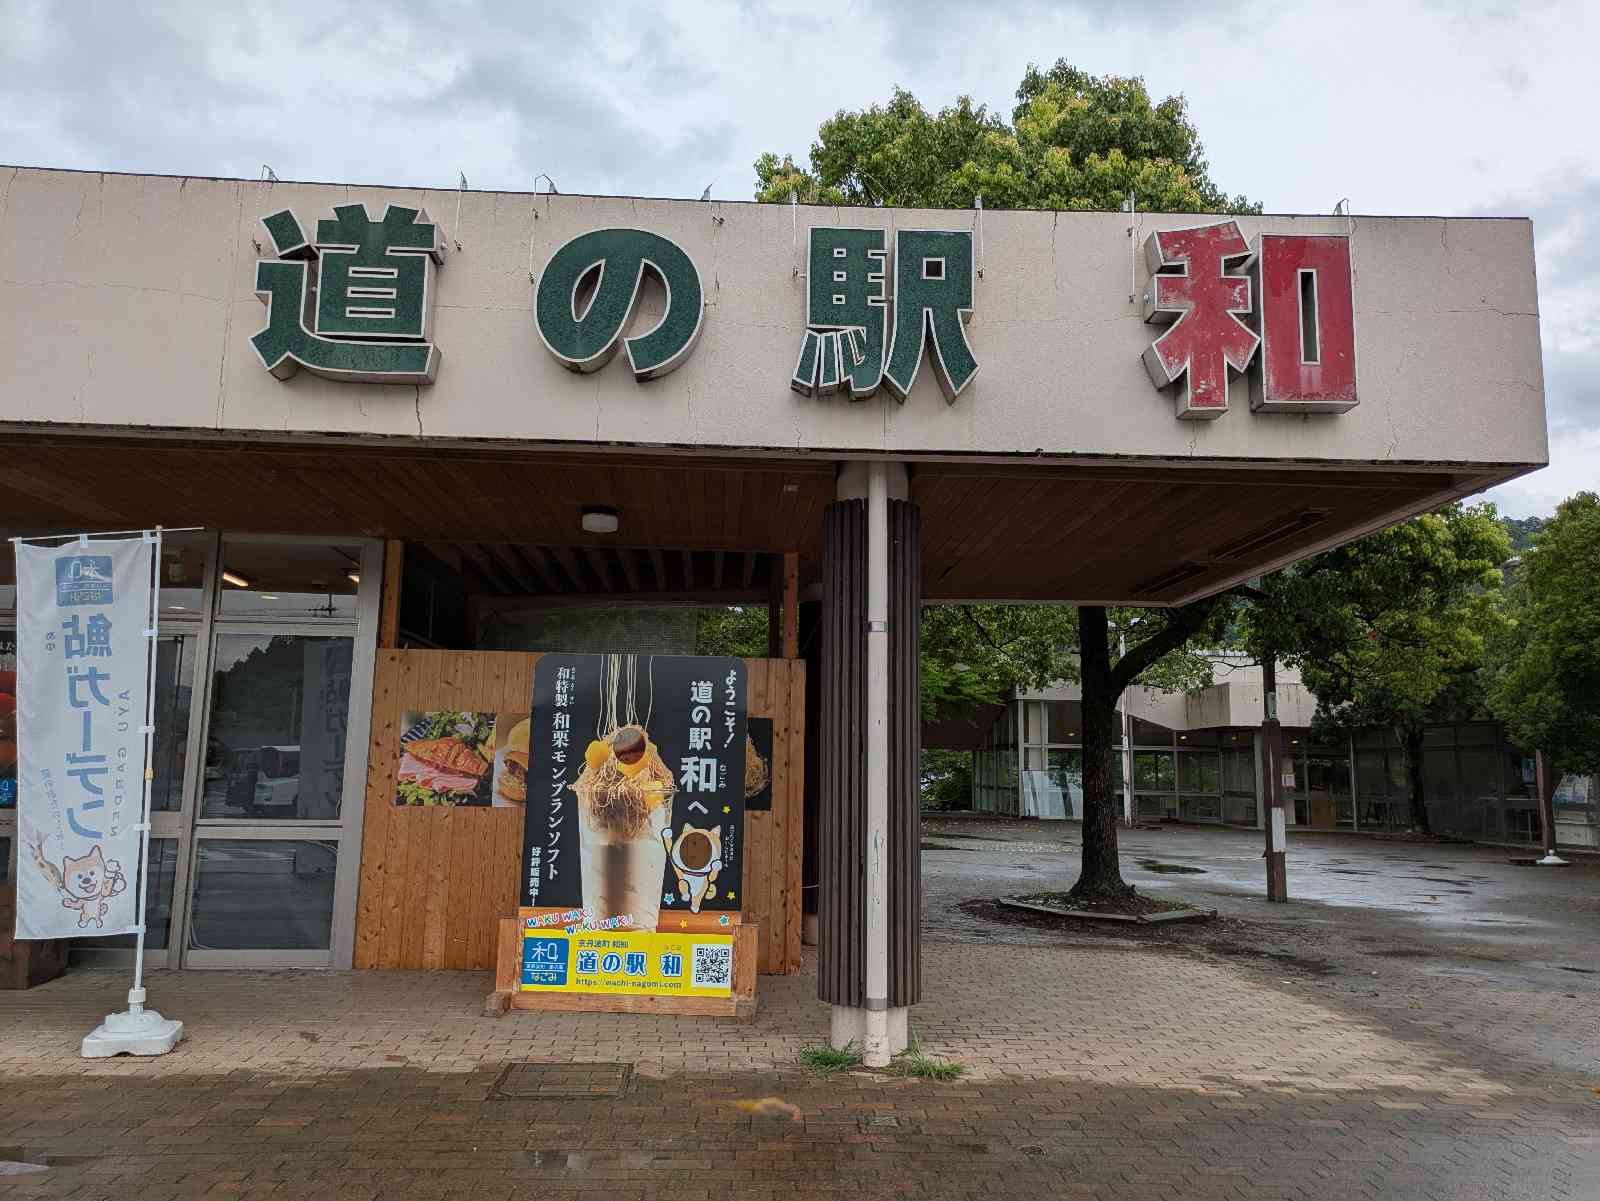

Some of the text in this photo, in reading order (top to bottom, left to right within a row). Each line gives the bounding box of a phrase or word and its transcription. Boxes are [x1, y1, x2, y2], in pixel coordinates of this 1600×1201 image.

[531, 941, 558, 962] 和
[576, 950, 683, 977] 道の駅 和
